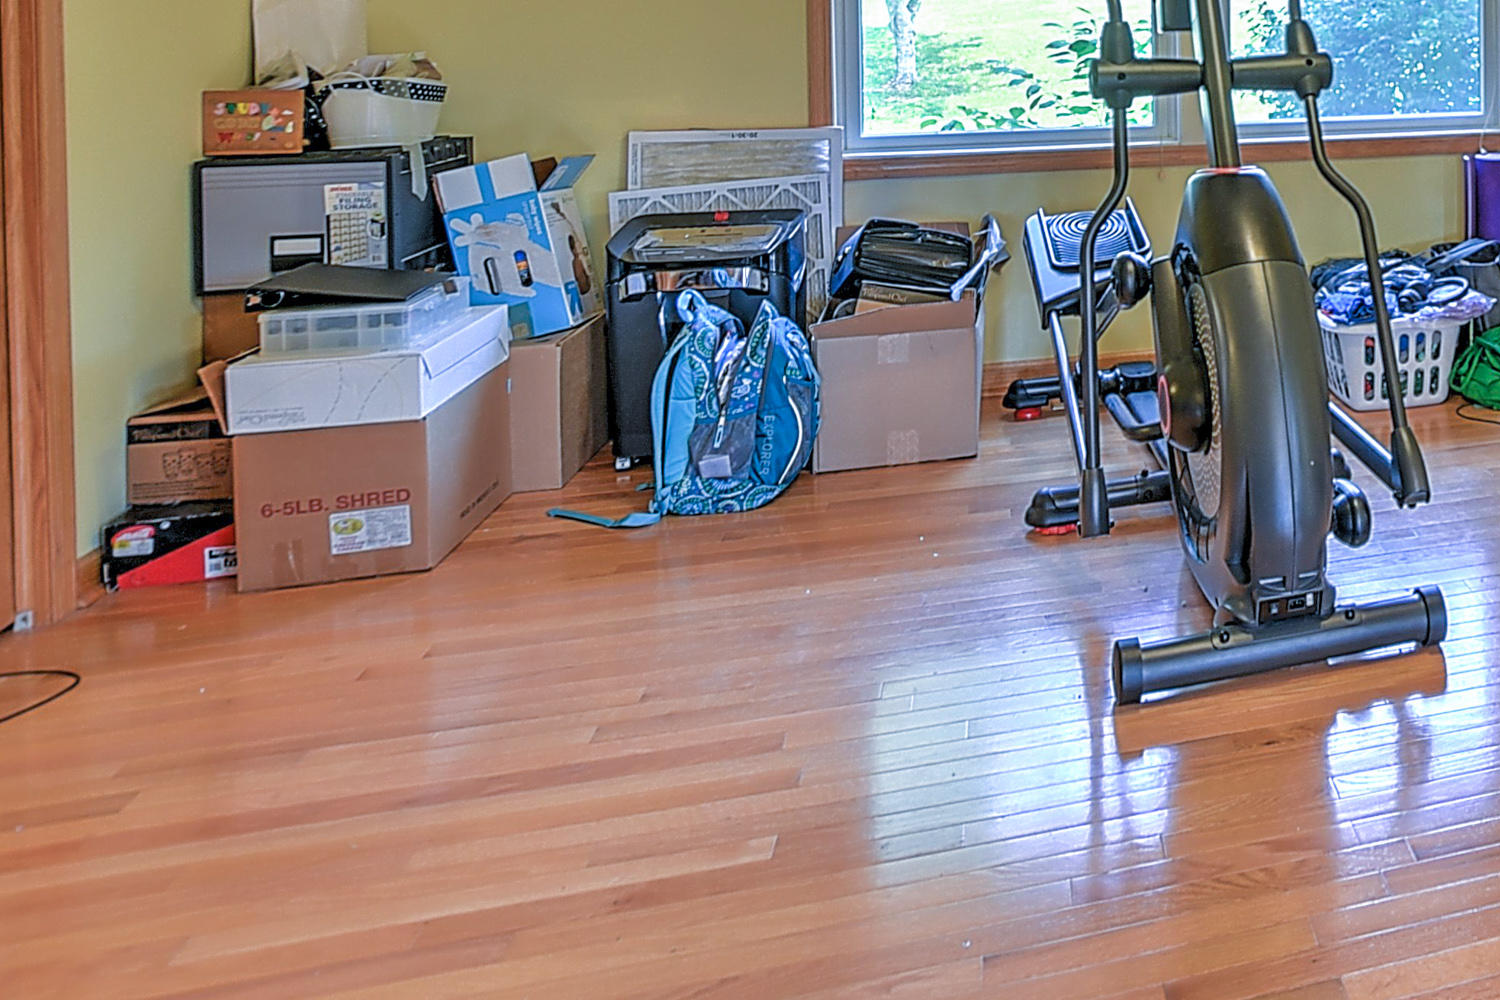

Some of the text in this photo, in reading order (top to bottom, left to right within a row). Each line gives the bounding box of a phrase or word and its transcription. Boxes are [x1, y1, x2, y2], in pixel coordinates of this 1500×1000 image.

[333, 201, 378, 211] STORAGE
[260, 488, 411, 518] 6-5LB. SHRED
